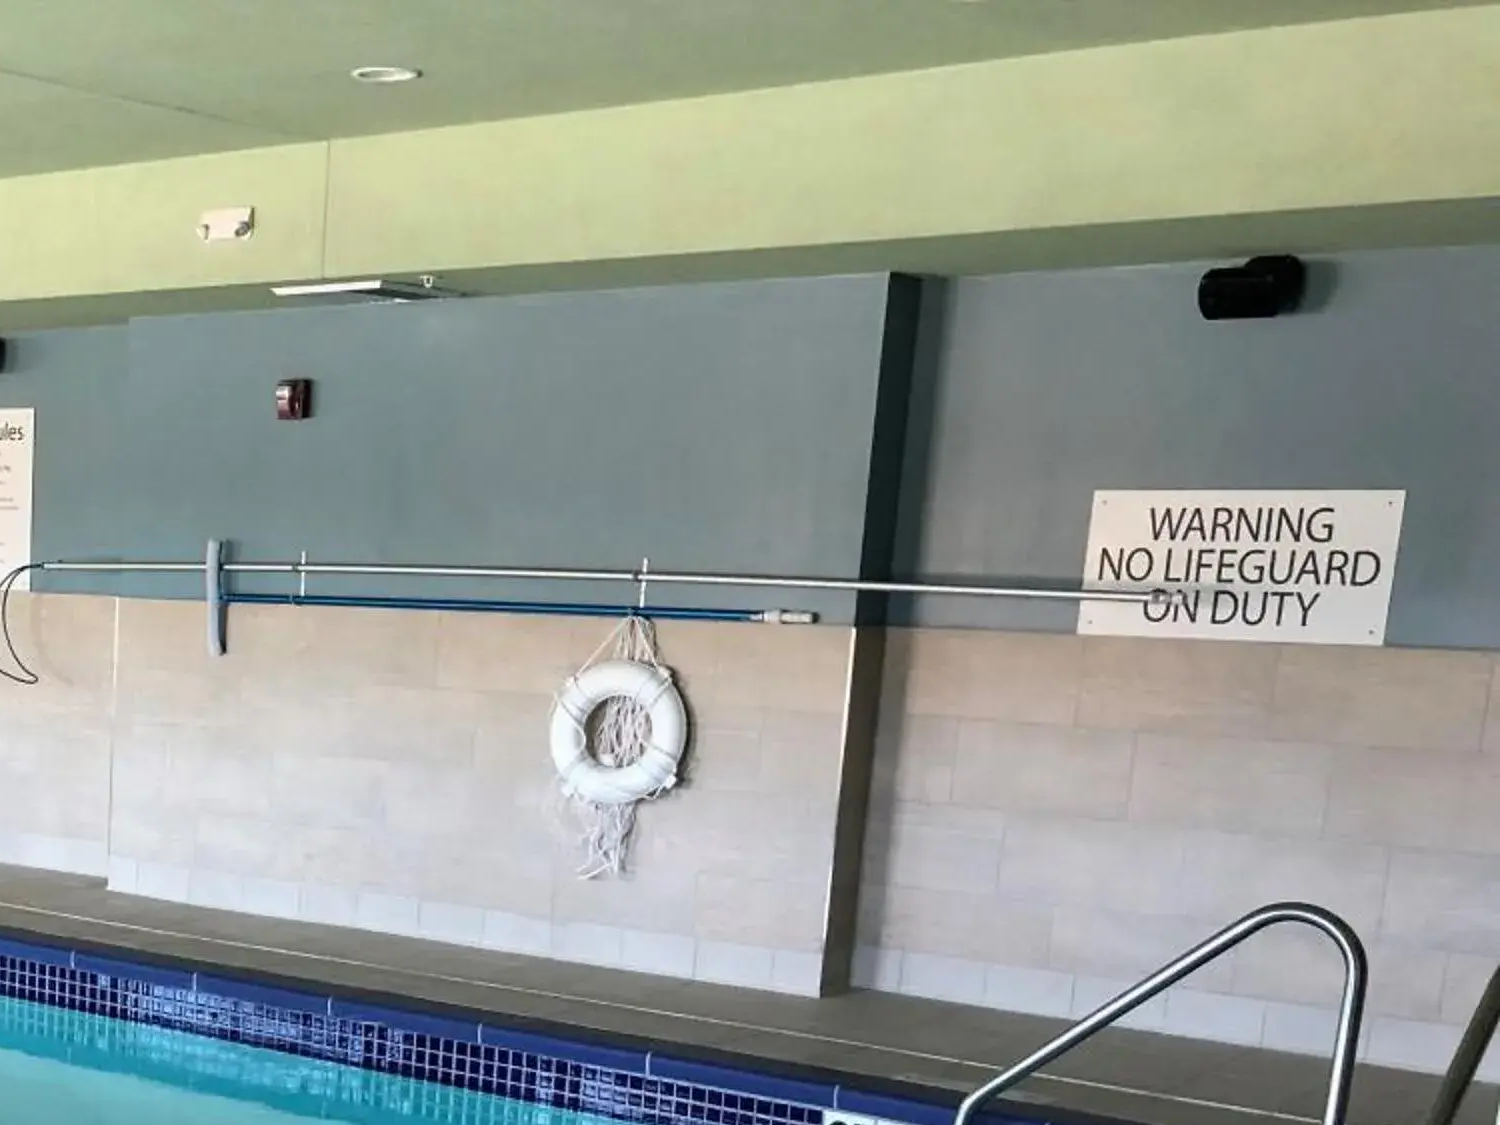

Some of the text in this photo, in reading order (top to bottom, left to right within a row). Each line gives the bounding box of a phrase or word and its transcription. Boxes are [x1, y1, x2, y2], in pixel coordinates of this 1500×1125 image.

[1150, 507, 1335, 543] WARNING
[1097, 547, 1381, 587] NO LIFEGUARD
[1143, 588, 1321, 627] ON DUTY
